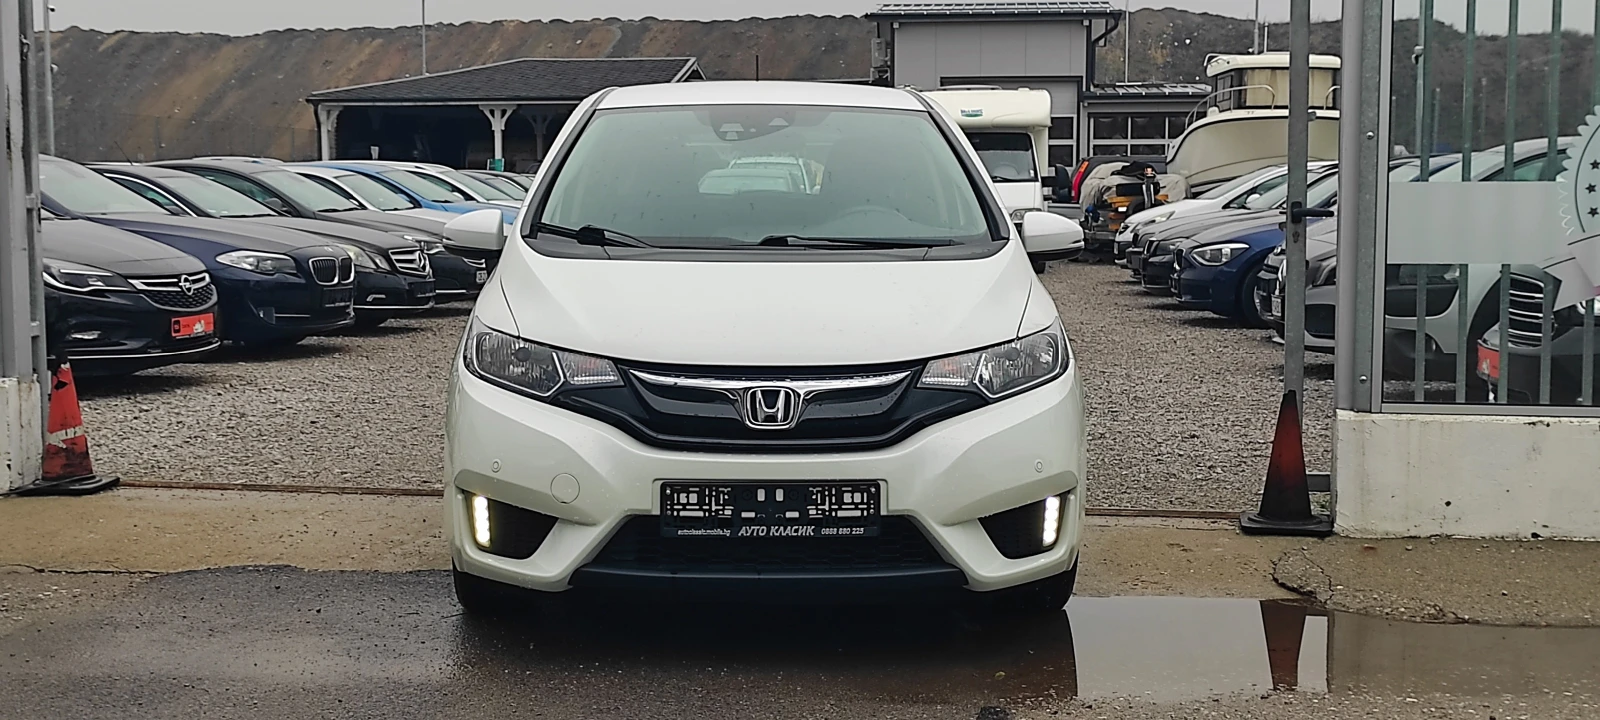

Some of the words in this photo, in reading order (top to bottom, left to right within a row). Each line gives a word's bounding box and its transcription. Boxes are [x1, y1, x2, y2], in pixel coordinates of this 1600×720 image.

[738, 525, 767, 537] АУТО
[769, 525, 815, 537] КЛАСИК
[821, 527, 837, 535] 0888
